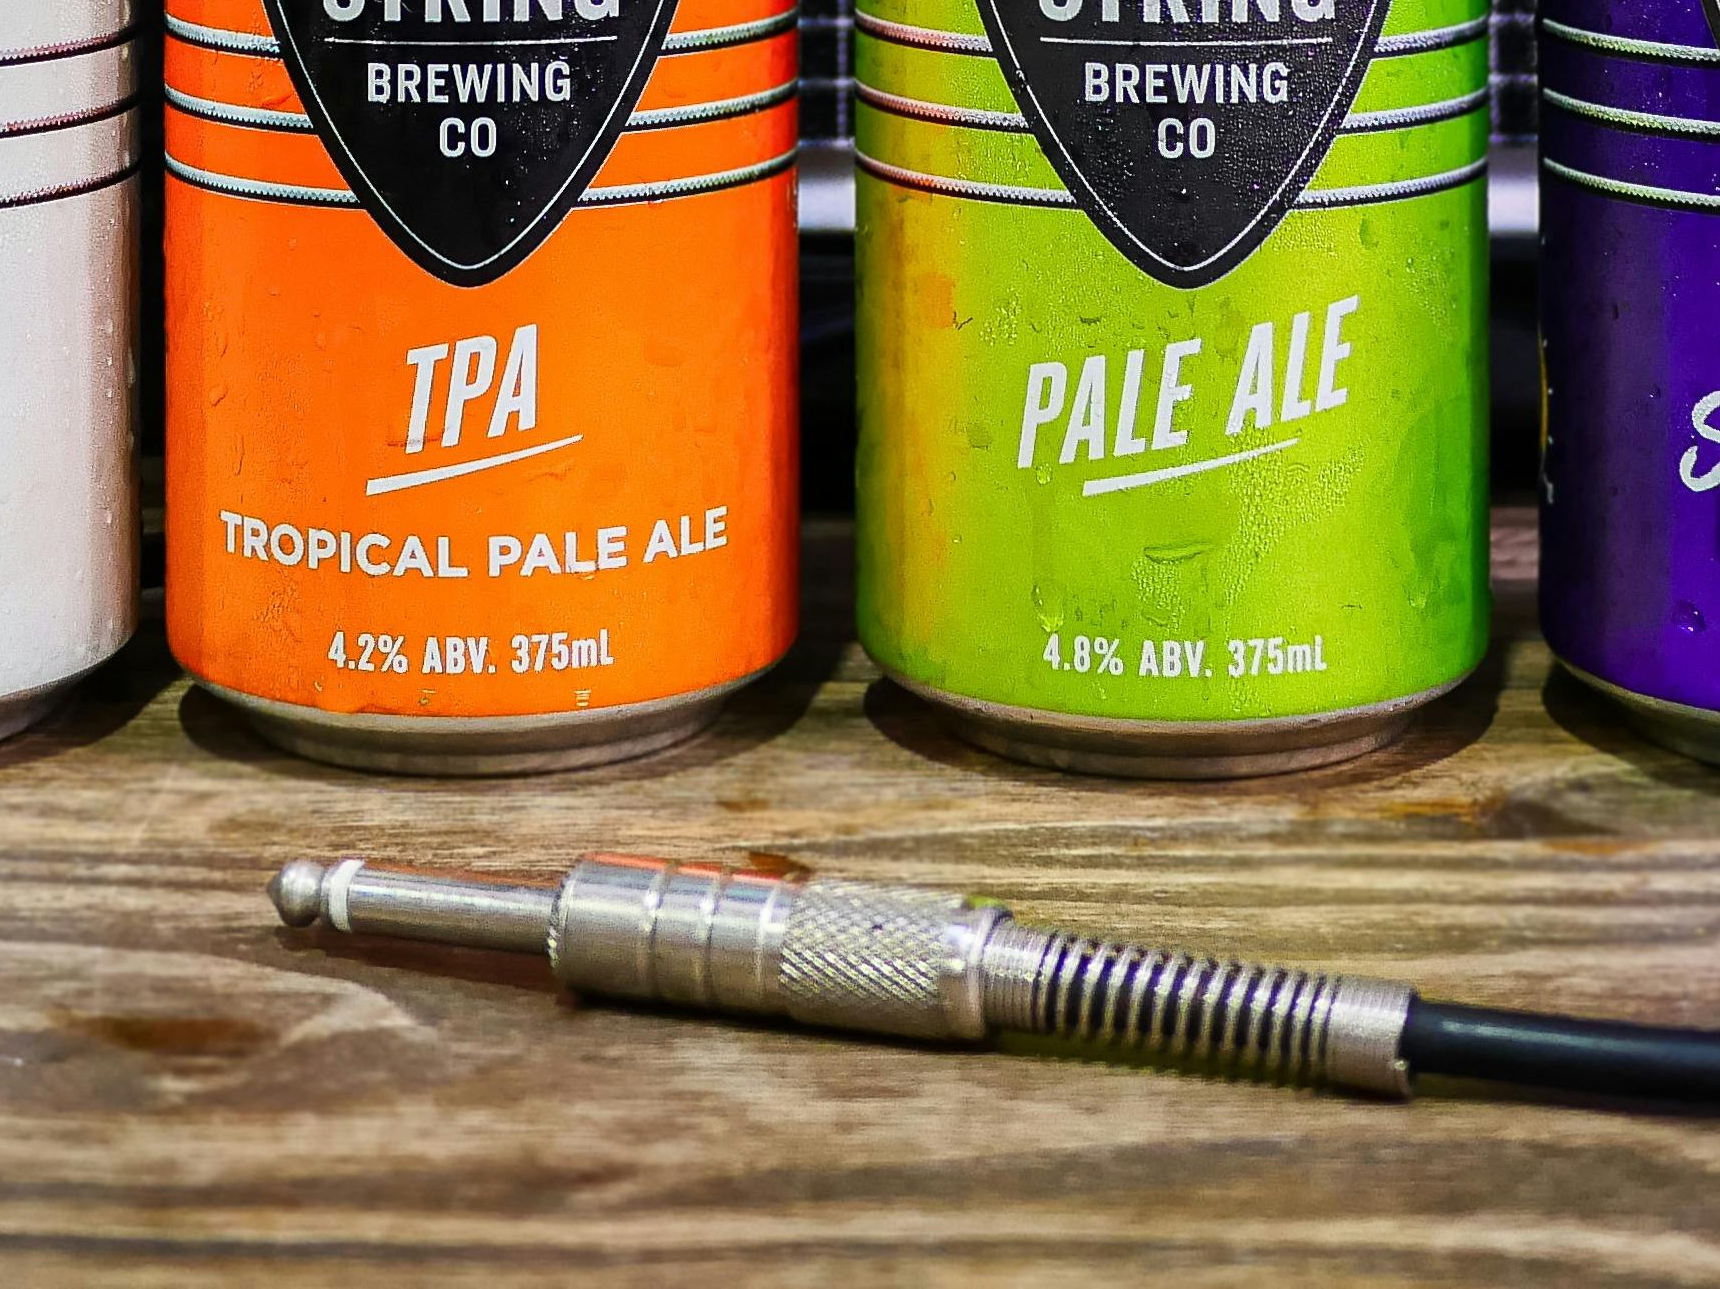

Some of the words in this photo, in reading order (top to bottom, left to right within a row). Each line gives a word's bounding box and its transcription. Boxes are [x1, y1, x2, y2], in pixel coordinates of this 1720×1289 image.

[367, 61, 571, 103] BREWING
[1085, 61, 1289, 103] BREWING
[440, 117, 497, 157] CO
[1158, 118, 1216, 159] CO
[404, 324, 538, 455] TPA
[1017, 338, 1202, 469] PALE
[1225, 295, 1359, 435] ALE
[220, 510, 468, 578] TROPICAL
[488, 526, 629, 578] PALE
[643, 506, 728, 563] ALE
[328, 633, 408, 674] 4.2%
[422, 635, 496, 675] ABV.
[511, 629, 614, 671] 375mL
[1043, 634, 1124, 677] 4.8%
[1139, 639, 1212, 678] ABV.
[1228, 635, 1327, 678] 375mL
